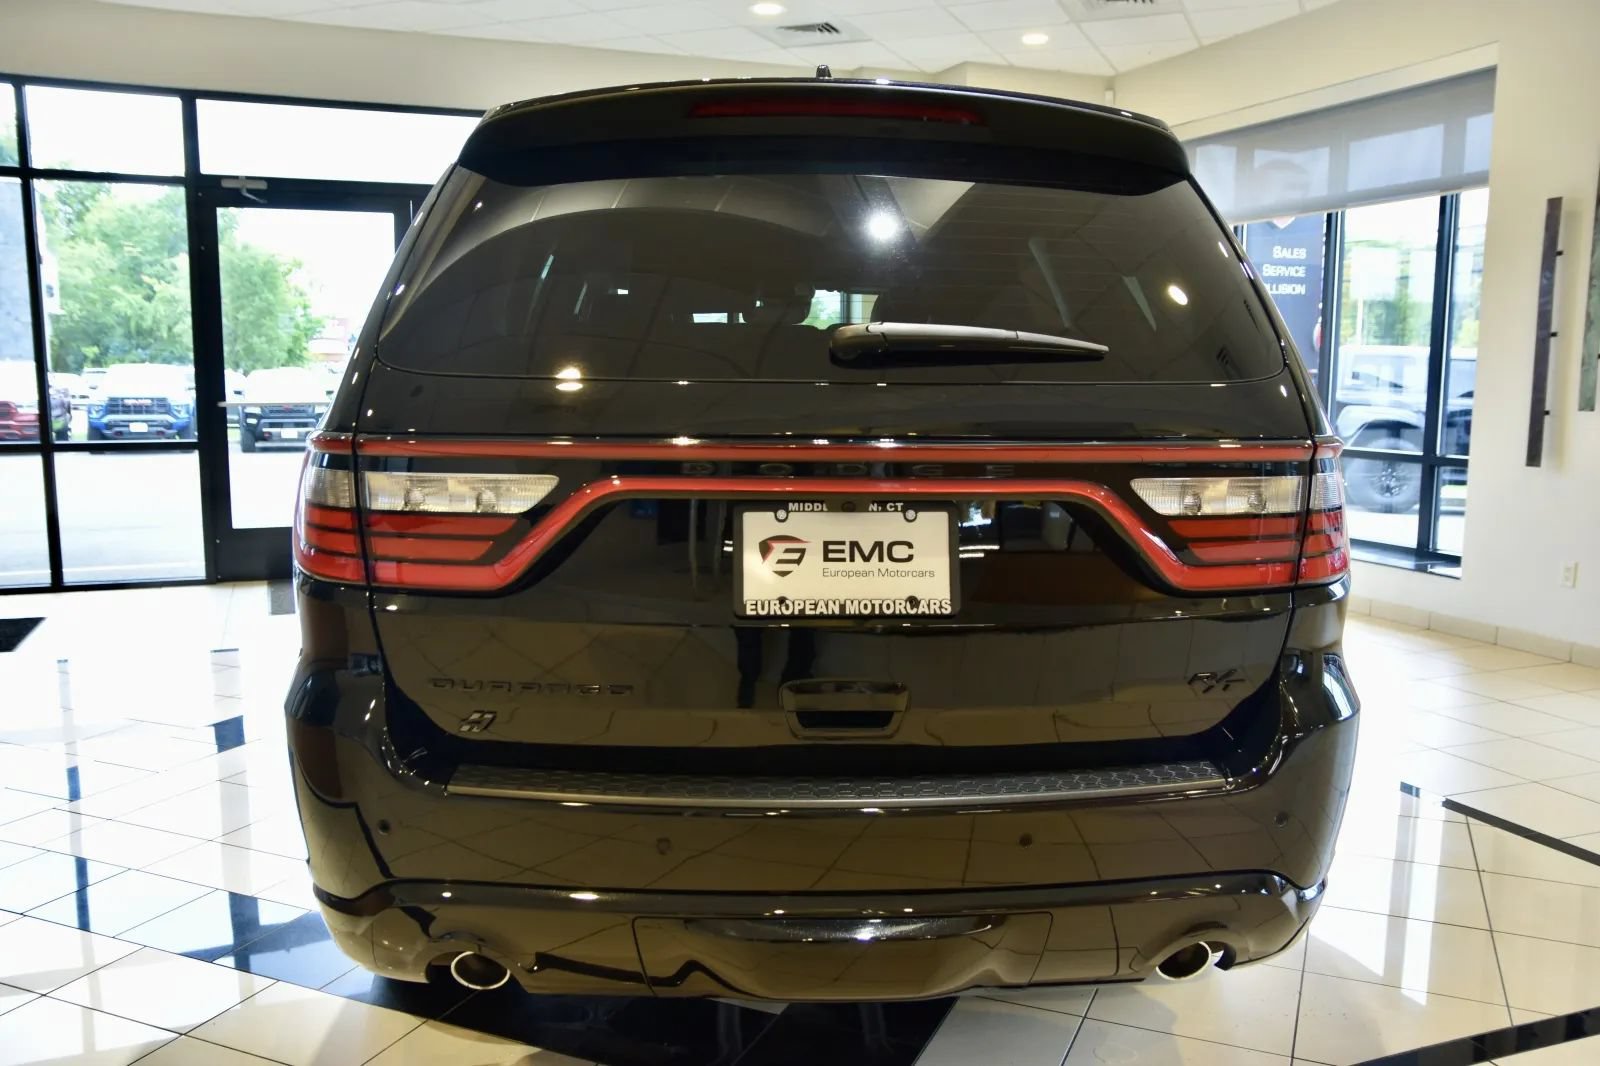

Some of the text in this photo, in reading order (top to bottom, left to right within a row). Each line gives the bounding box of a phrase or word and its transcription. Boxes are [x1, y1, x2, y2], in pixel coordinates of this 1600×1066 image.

[1273, 246, 1307, 259] SALES
[1263, 264, 1306, 277] SERVICE
[681, 462, 1014, 477] DODGE
[886, 502, 904, 512] CT
[822, 541, 914, 563] EMC
[822, 567, 935, 580] European Motorcars
[745, 599, 952, 615] EUROPEAN MOTORCARS
